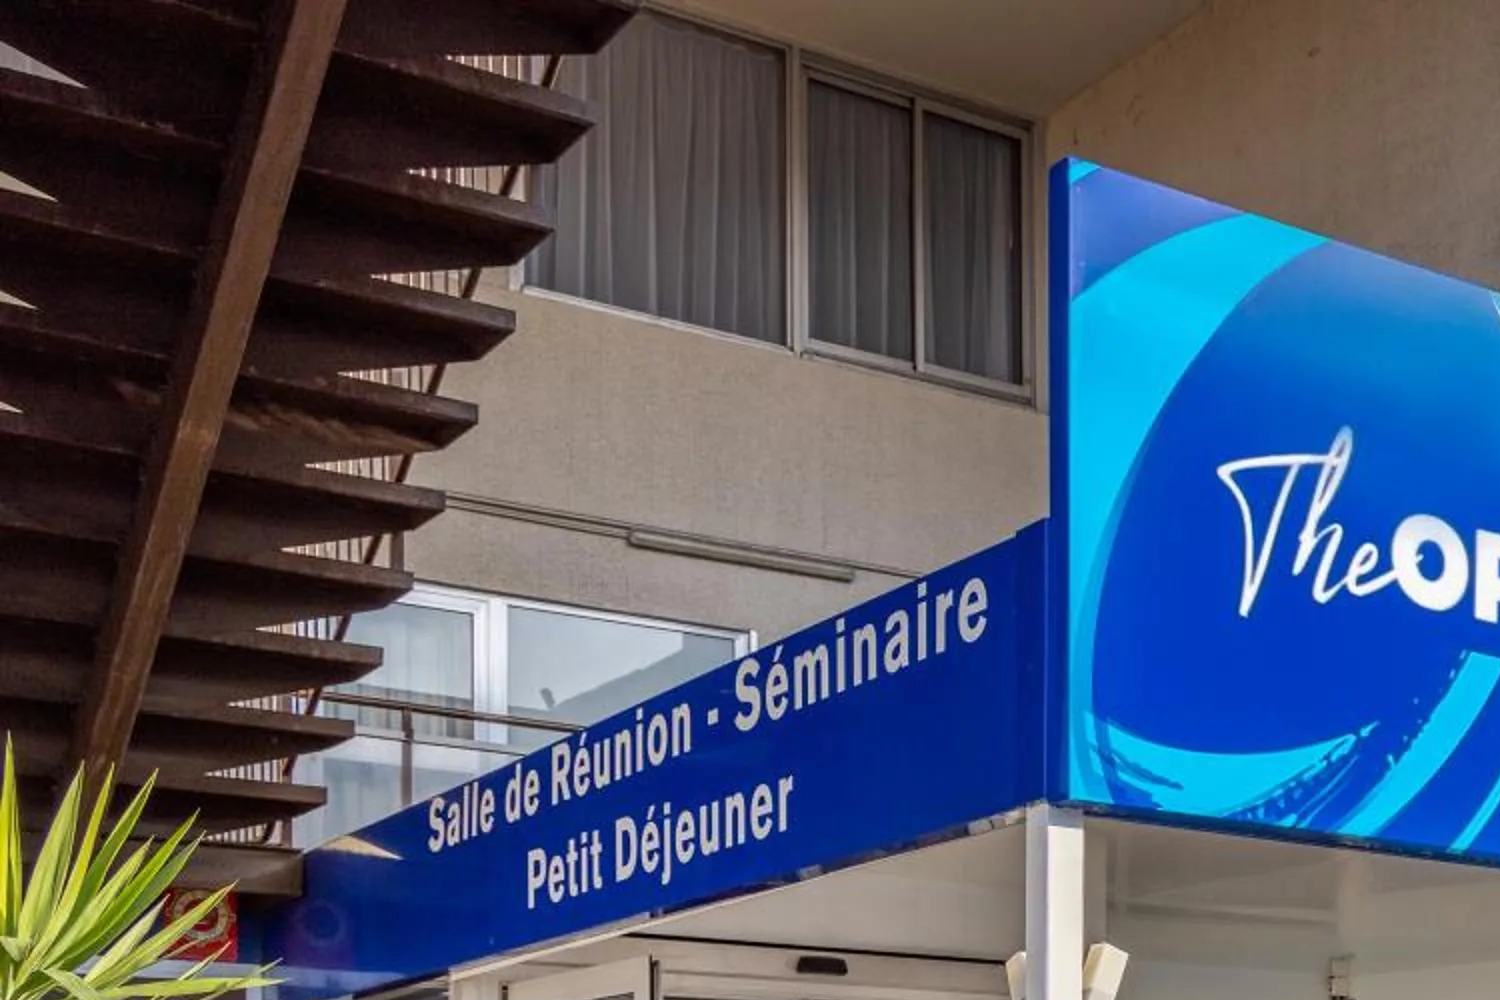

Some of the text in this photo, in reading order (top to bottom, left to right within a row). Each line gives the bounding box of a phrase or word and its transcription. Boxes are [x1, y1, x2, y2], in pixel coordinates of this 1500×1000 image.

[1217, 425, 1394, 617] The
[428, 780, 494, 853] Salle
[505, 763, 540, 825] de
[551, 700, 690, 805] Réunion
[733, 576, 988, 733] Séminaire
[526, 774, 794, 908] Petit Déjeuner
